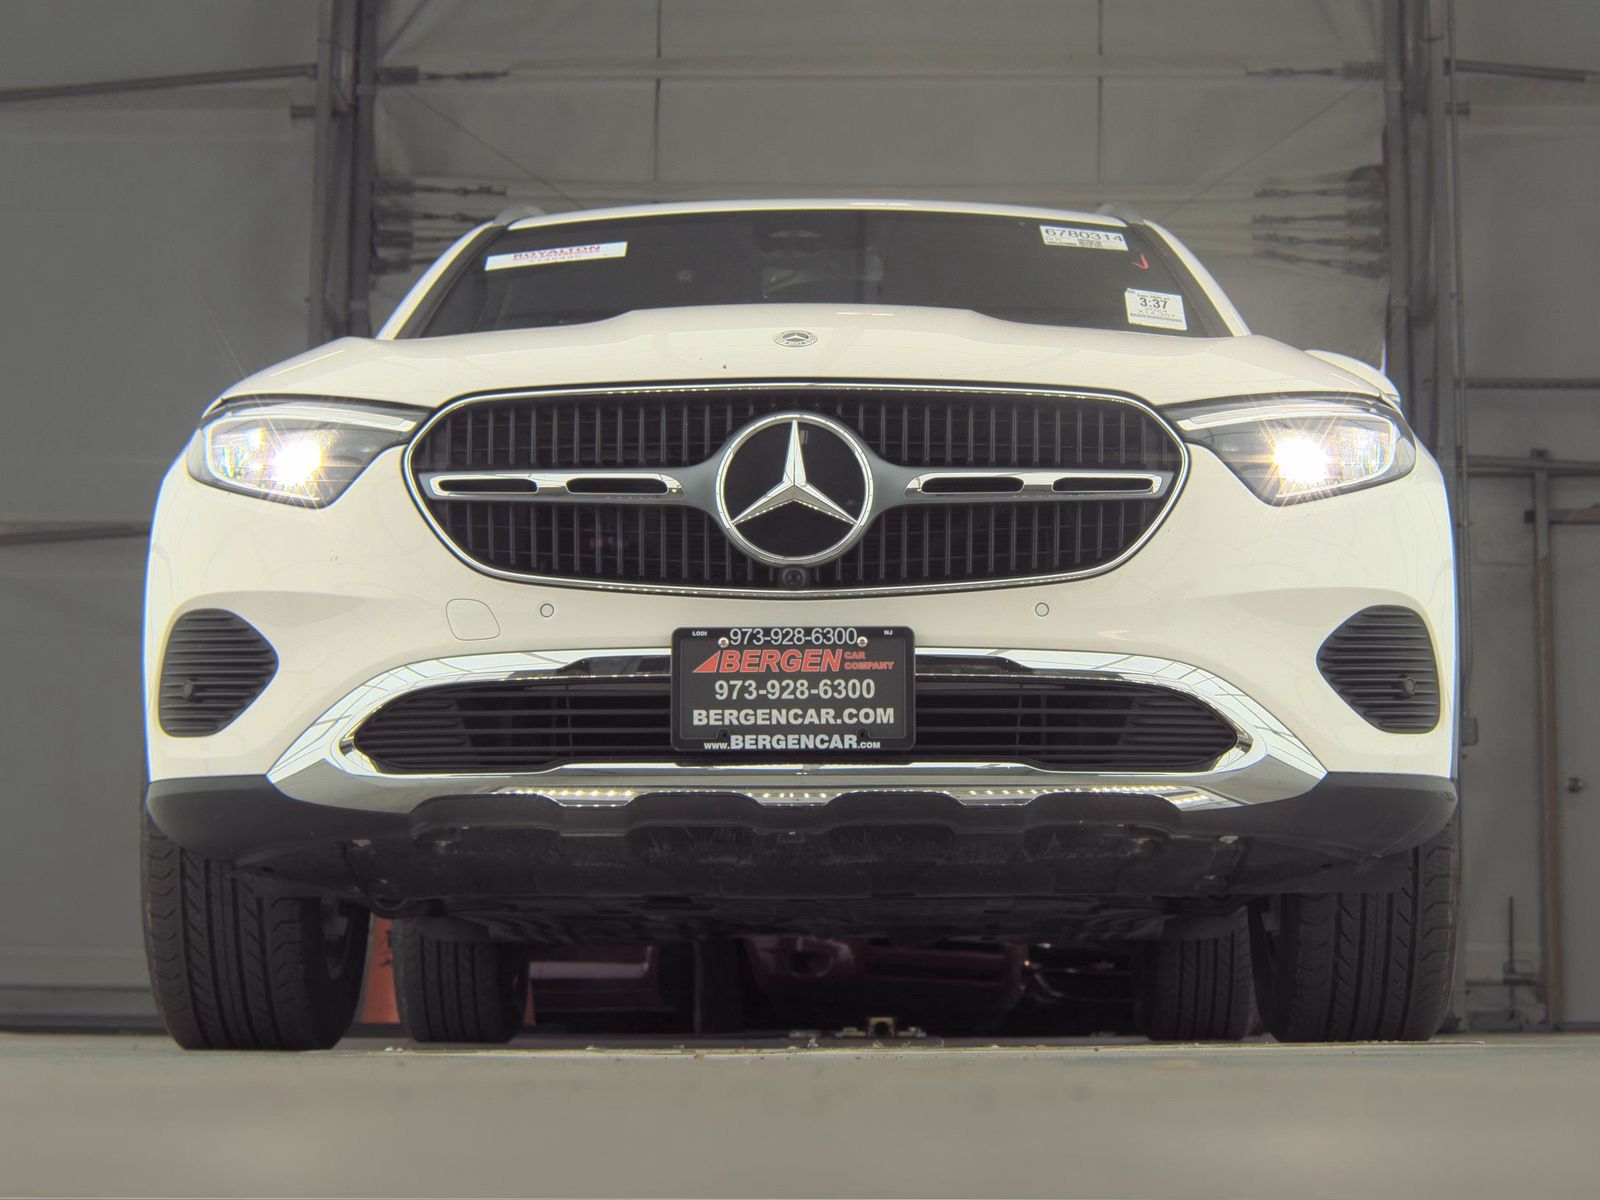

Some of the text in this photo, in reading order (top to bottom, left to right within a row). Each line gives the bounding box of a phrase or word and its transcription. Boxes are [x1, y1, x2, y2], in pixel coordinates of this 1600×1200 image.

[1045, 229, 1123, 242] 6780314
[512, 245, 600, 261] ROYALTON
[1139, 297, 1168, 309] 3:37
[729, 627, 858, 646] 973-928-6300
[719, 649, 843, 673] BERGEN
[844, 651, 866, 660] CAR
[844, 661, 895, 671] COMPANY
[714, 678, 875, 700] 973-928-6300
[692, 707, 895, 726] BERGENCAR.COM
